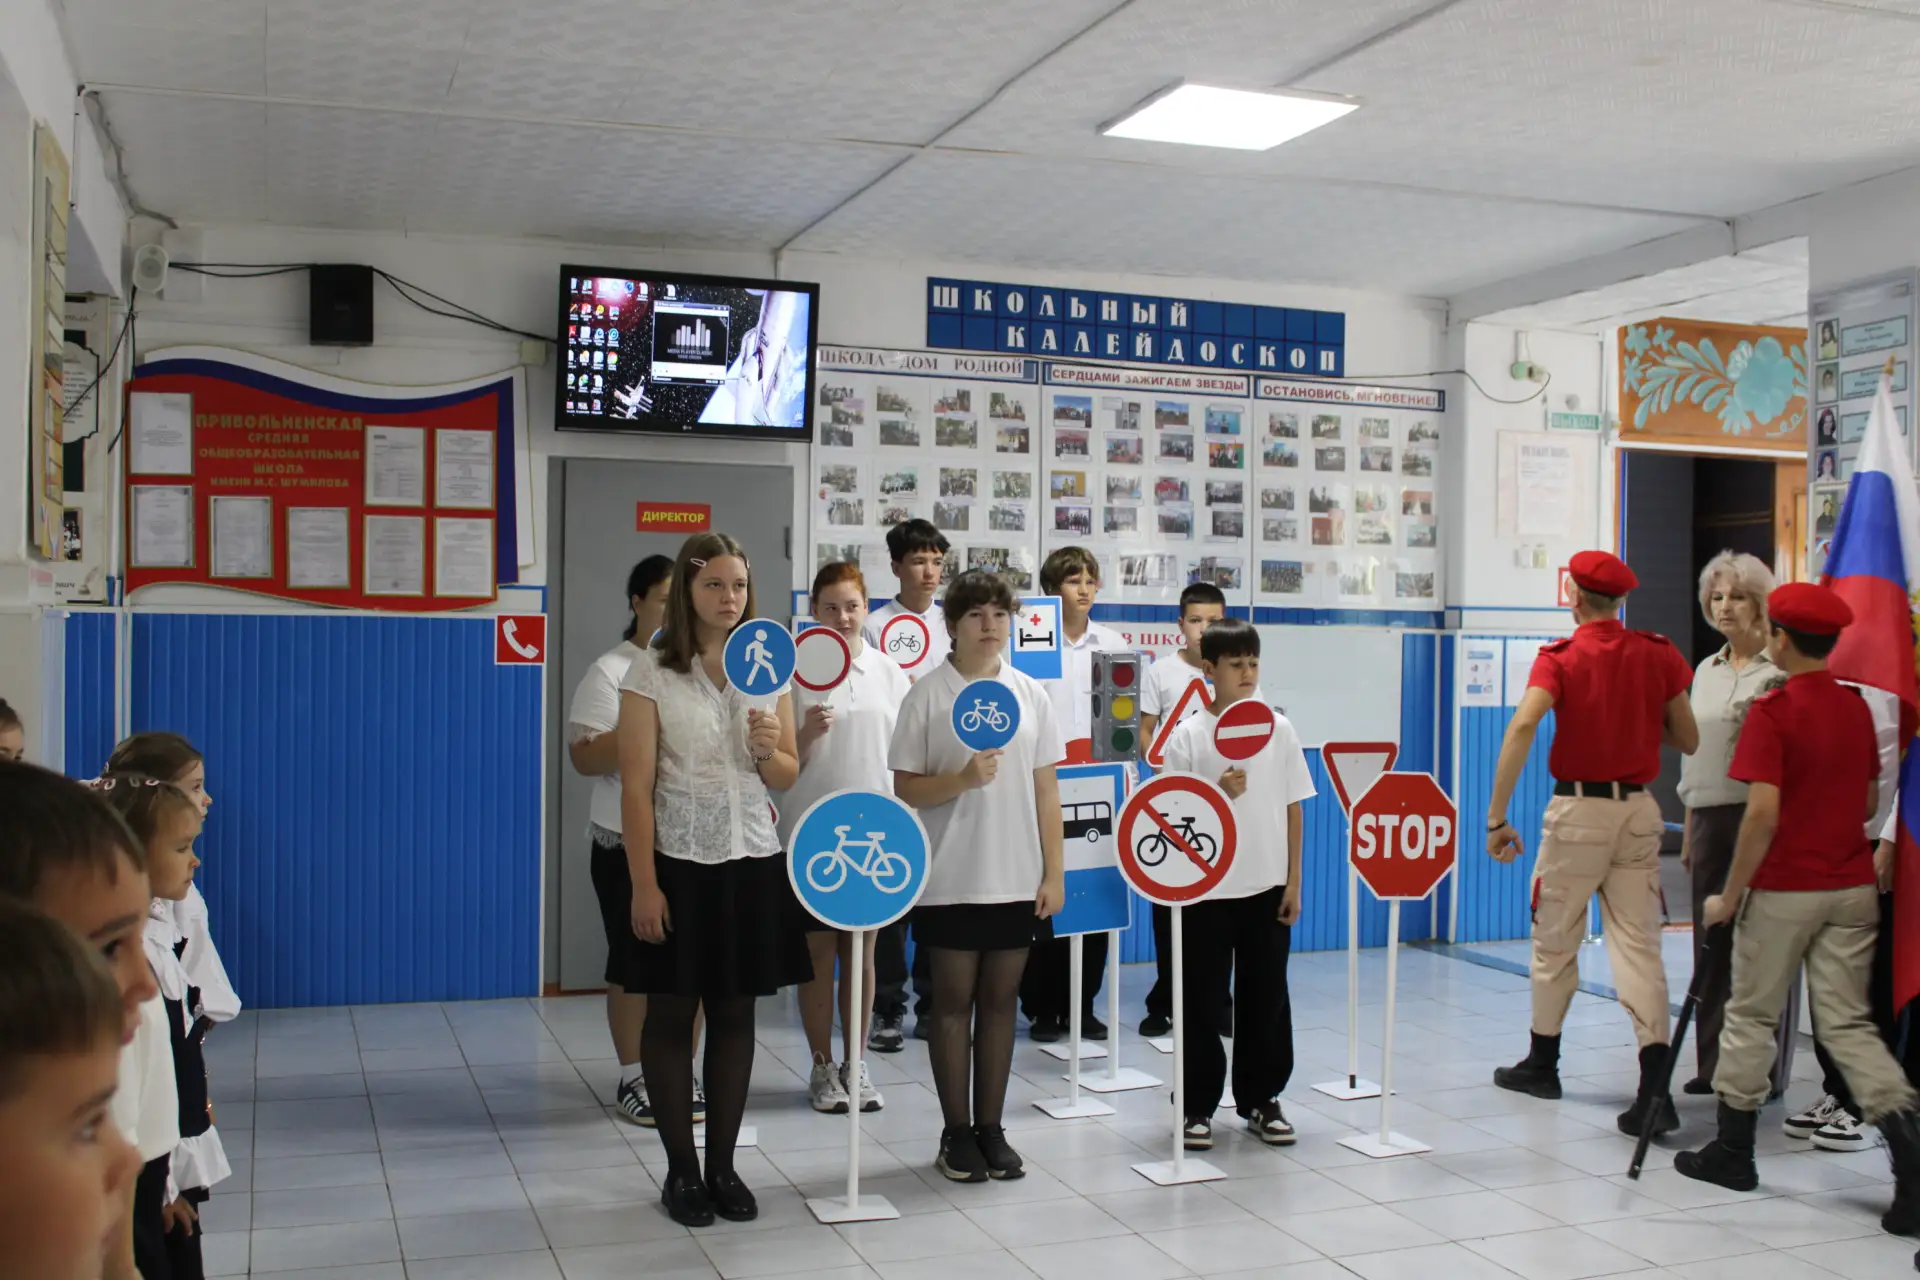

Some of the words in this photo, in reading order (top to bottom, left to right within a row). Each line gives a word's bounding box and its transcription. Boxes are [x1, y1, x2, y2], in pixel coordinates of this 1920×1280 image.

[932, 285, 1188, 327] ШКОЛЬНЫЙ
[1007, 326, 1336, 371] КАЛЕЙДОСКОП
[819, 349, 885, 366] ШКОЛА
[900, 356, 938, 370] ДОМ
[954, 358, 1023, 375] РОДНОЙ
[1052, 369, 1120, 383] СЕРДЦАМИ
[1124, 374, 1191, 388] ЗАЖИГАЕМ
[1196, 379, 1244, 391] ЗВЕЗДЫ
[1263, 384, 1354, 402] ОСТАНОВИСЬ,
[1357, 391, 1436, 406] МГНОВЕНИЕ!
[196, 413, 363, 431] ПРИВОЛЬНЕНСКАЯ
[248, 433, 309, 444] СРЕДНЯЯ
[200, 448, 359, 460] ОБЩЕОБРАЗОВАТЕЛЬНАЯ
[253, 463, 304, 474] ШКОЛА
[210, 477, 250, 487] ИМЕНИ
[280, 477, 349, 487] ШУМИЛОВА
[642, 511, 705, 523] ДИРЕКТОР
[1140, 633, 1188, 646] ШКО
[1357, 813, 1451, 860] STOP
